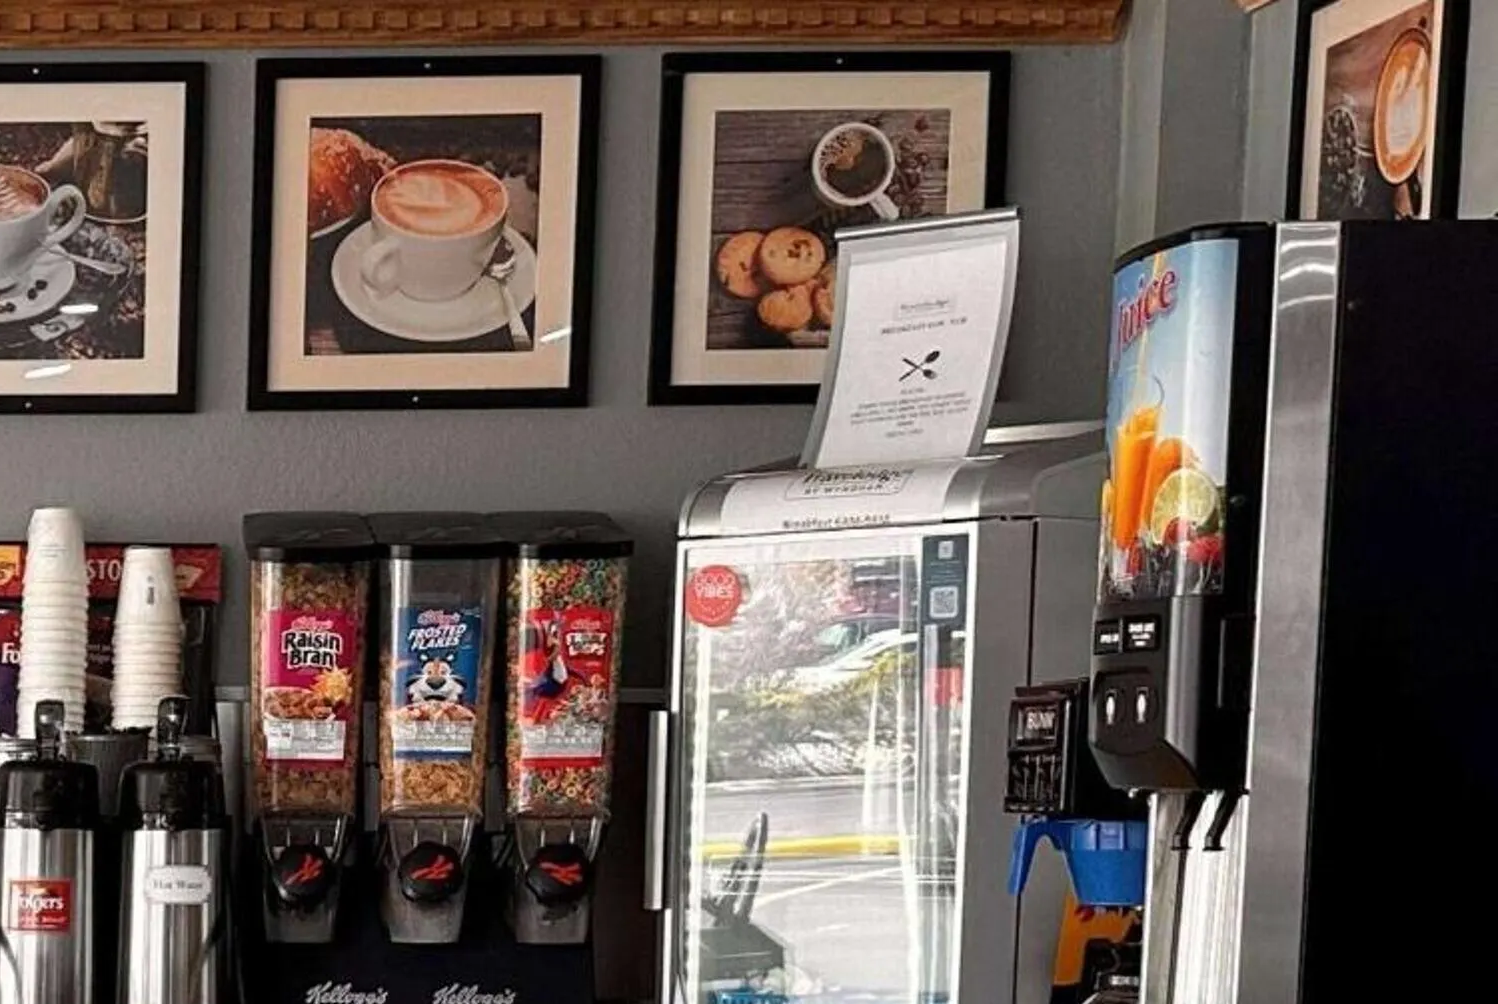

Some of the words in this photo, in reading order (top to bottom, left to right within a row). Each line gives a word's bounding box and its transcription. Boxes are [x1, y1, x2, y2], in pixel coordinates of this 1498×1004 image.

[408, 623, 468, 641] FROSTED
[282, 631, 342, 653] Raisin
[411, 635, 461, 651] FLAKES
[288, 648, 335, 669] Bran
